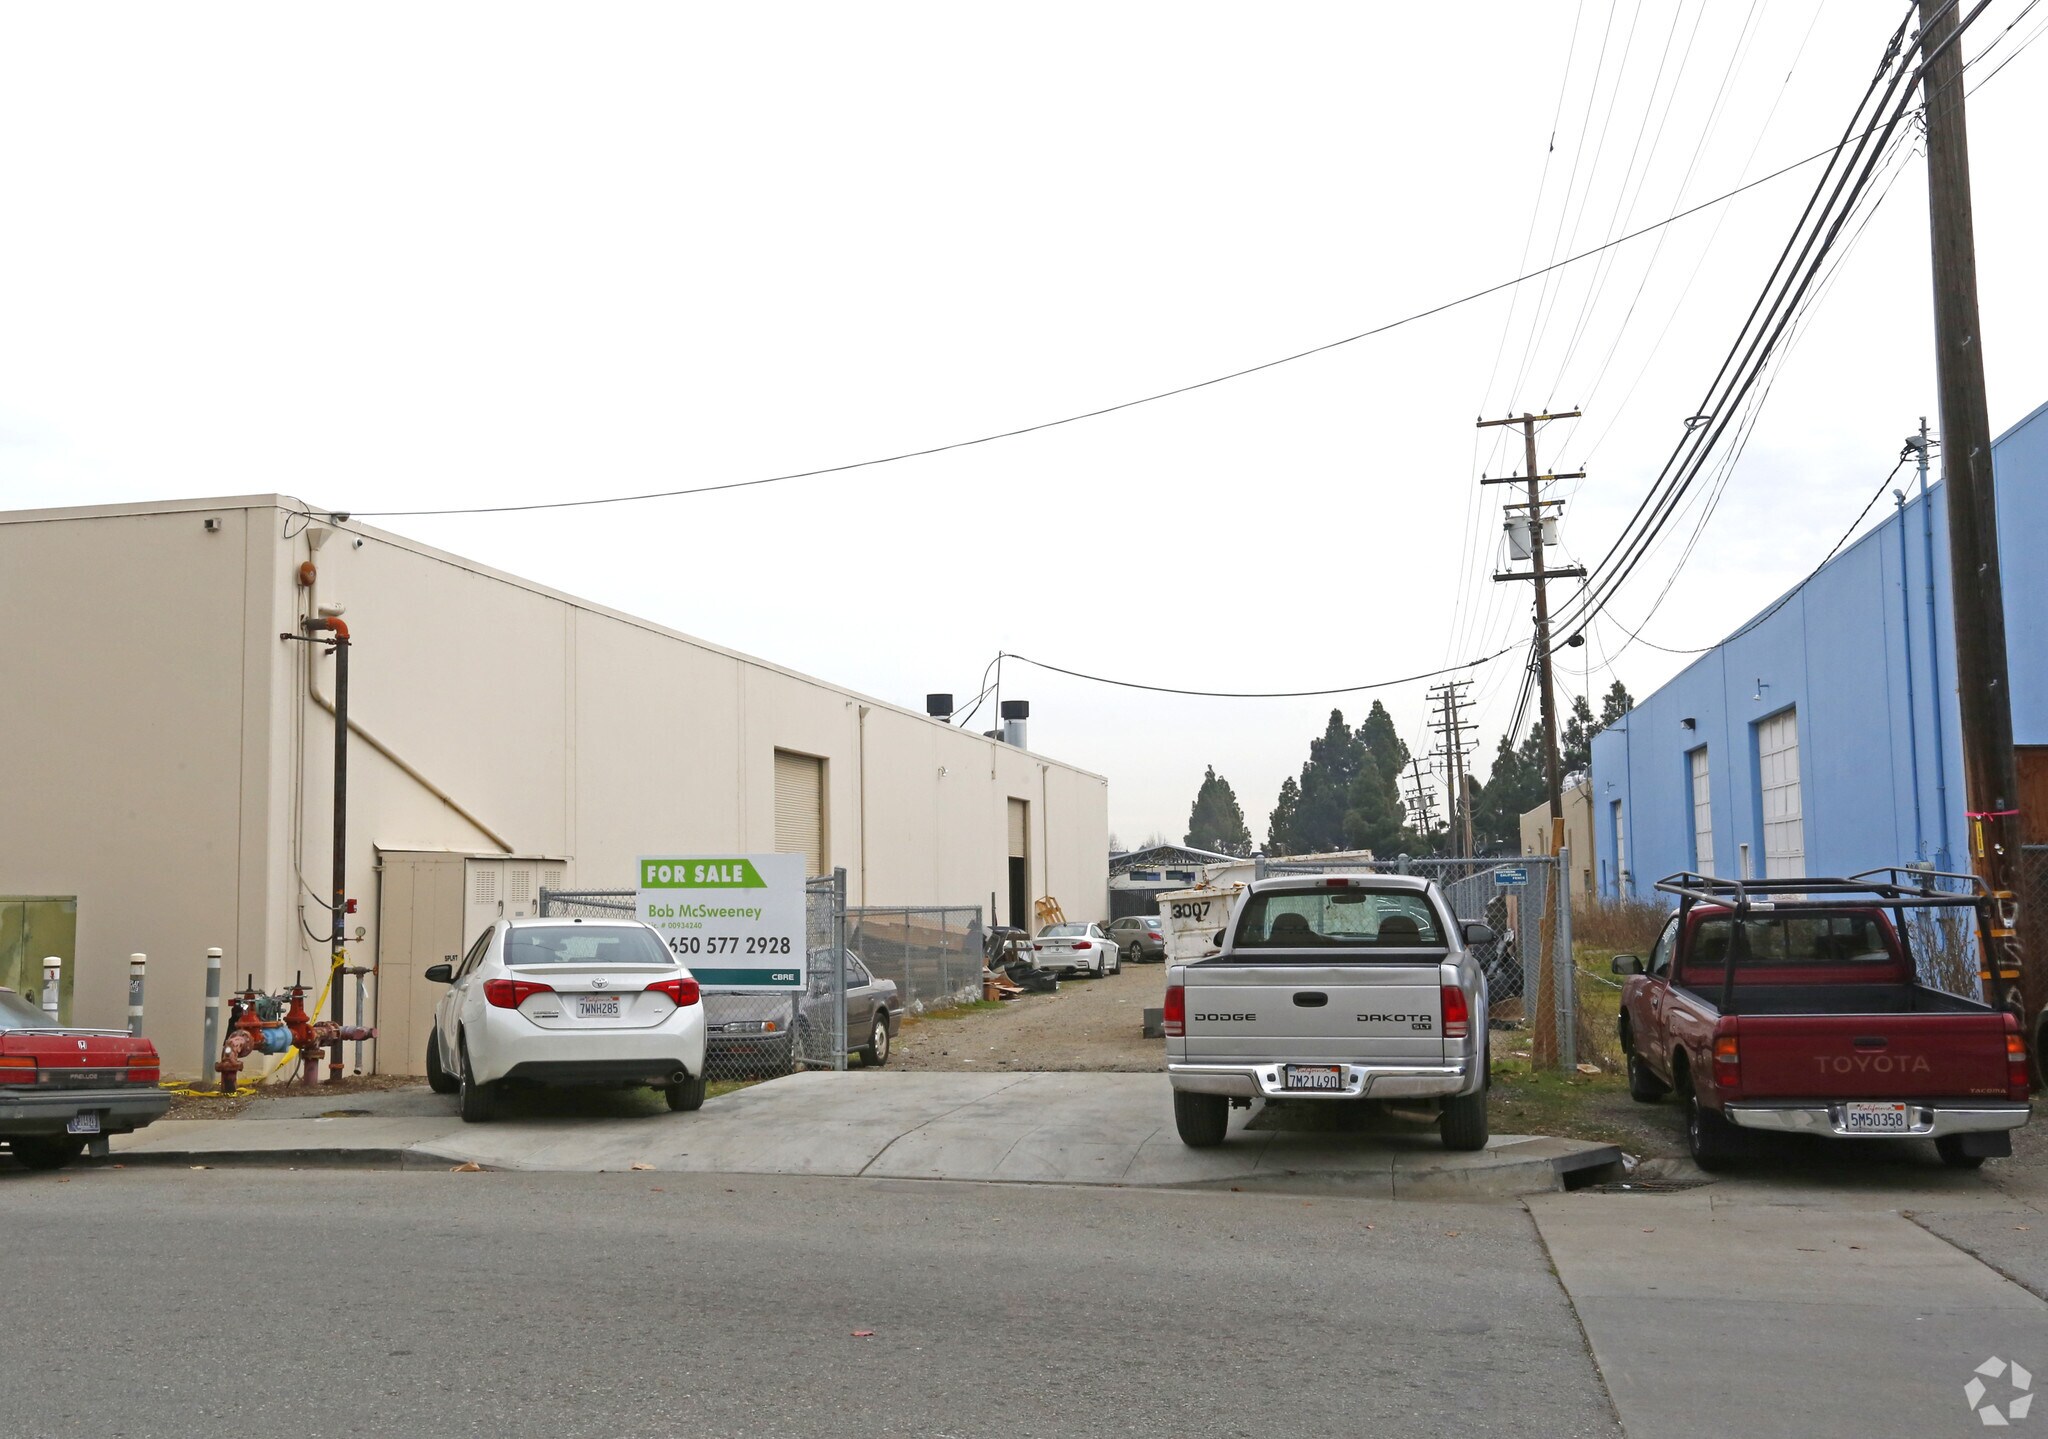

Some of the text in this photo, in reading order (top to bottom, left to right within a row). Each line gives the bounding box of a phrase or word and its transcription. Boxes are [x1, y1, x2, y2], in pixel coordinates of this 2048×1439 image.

[647, 865, 743, 883] FOR SALE
[648, 904, 762, 921] Bob McSweeney
[1172, 901, 1211, 919] 3007
[669, 936, 791, 954] 650 577 2928
[771, 973, 795, 981] CBRE
[580, 1003, 619, 1014] 7WNH285
[1194, 1013, 1257, 1021] DODGE
[1356, 1014, 1432, 1022] DAKOTA
[1813, 1055, 1931, 1073] TOYOTA
[1289, 1075, 1337, 1088] 7M21490
[1850, 1112, 1904, 1127] 5M50358
